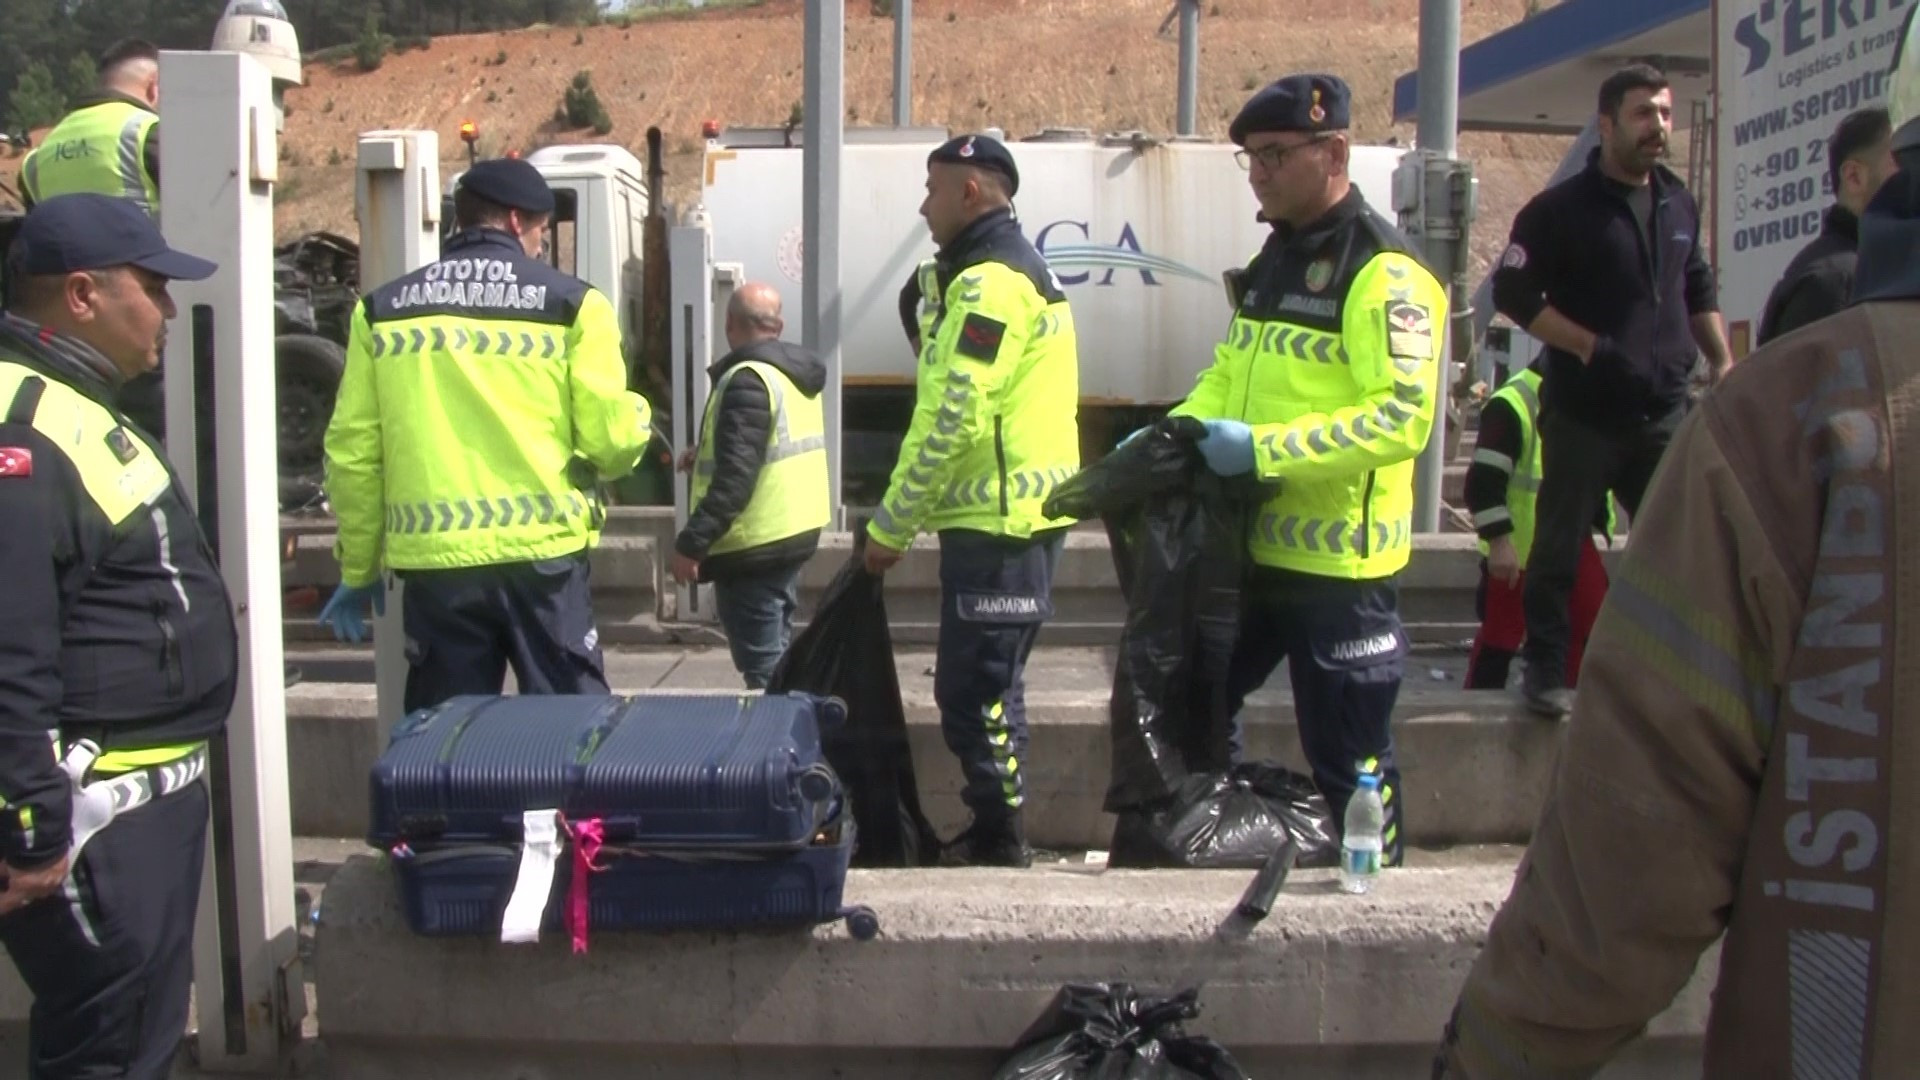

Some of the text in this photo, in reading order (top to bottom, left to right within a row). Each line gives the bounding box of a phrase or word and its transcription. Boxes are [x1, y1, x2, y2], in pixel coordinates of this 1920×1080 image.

[1777, 52, 1841, 88] Logistics
[1861, 25, 1898, 54] tran
[1733, 68, 1890, 147] www.seraytr
[1751, 147, 1799, 177] +90
[1751, 176, 1815, 211] +380
[1035, 220, 1162, 286] CA
[425, 258, 518, 282] OTOYOL
[391, 280, 547, 311] JANDARMASI
[974, 597, 1039, 613] JANDARMA
